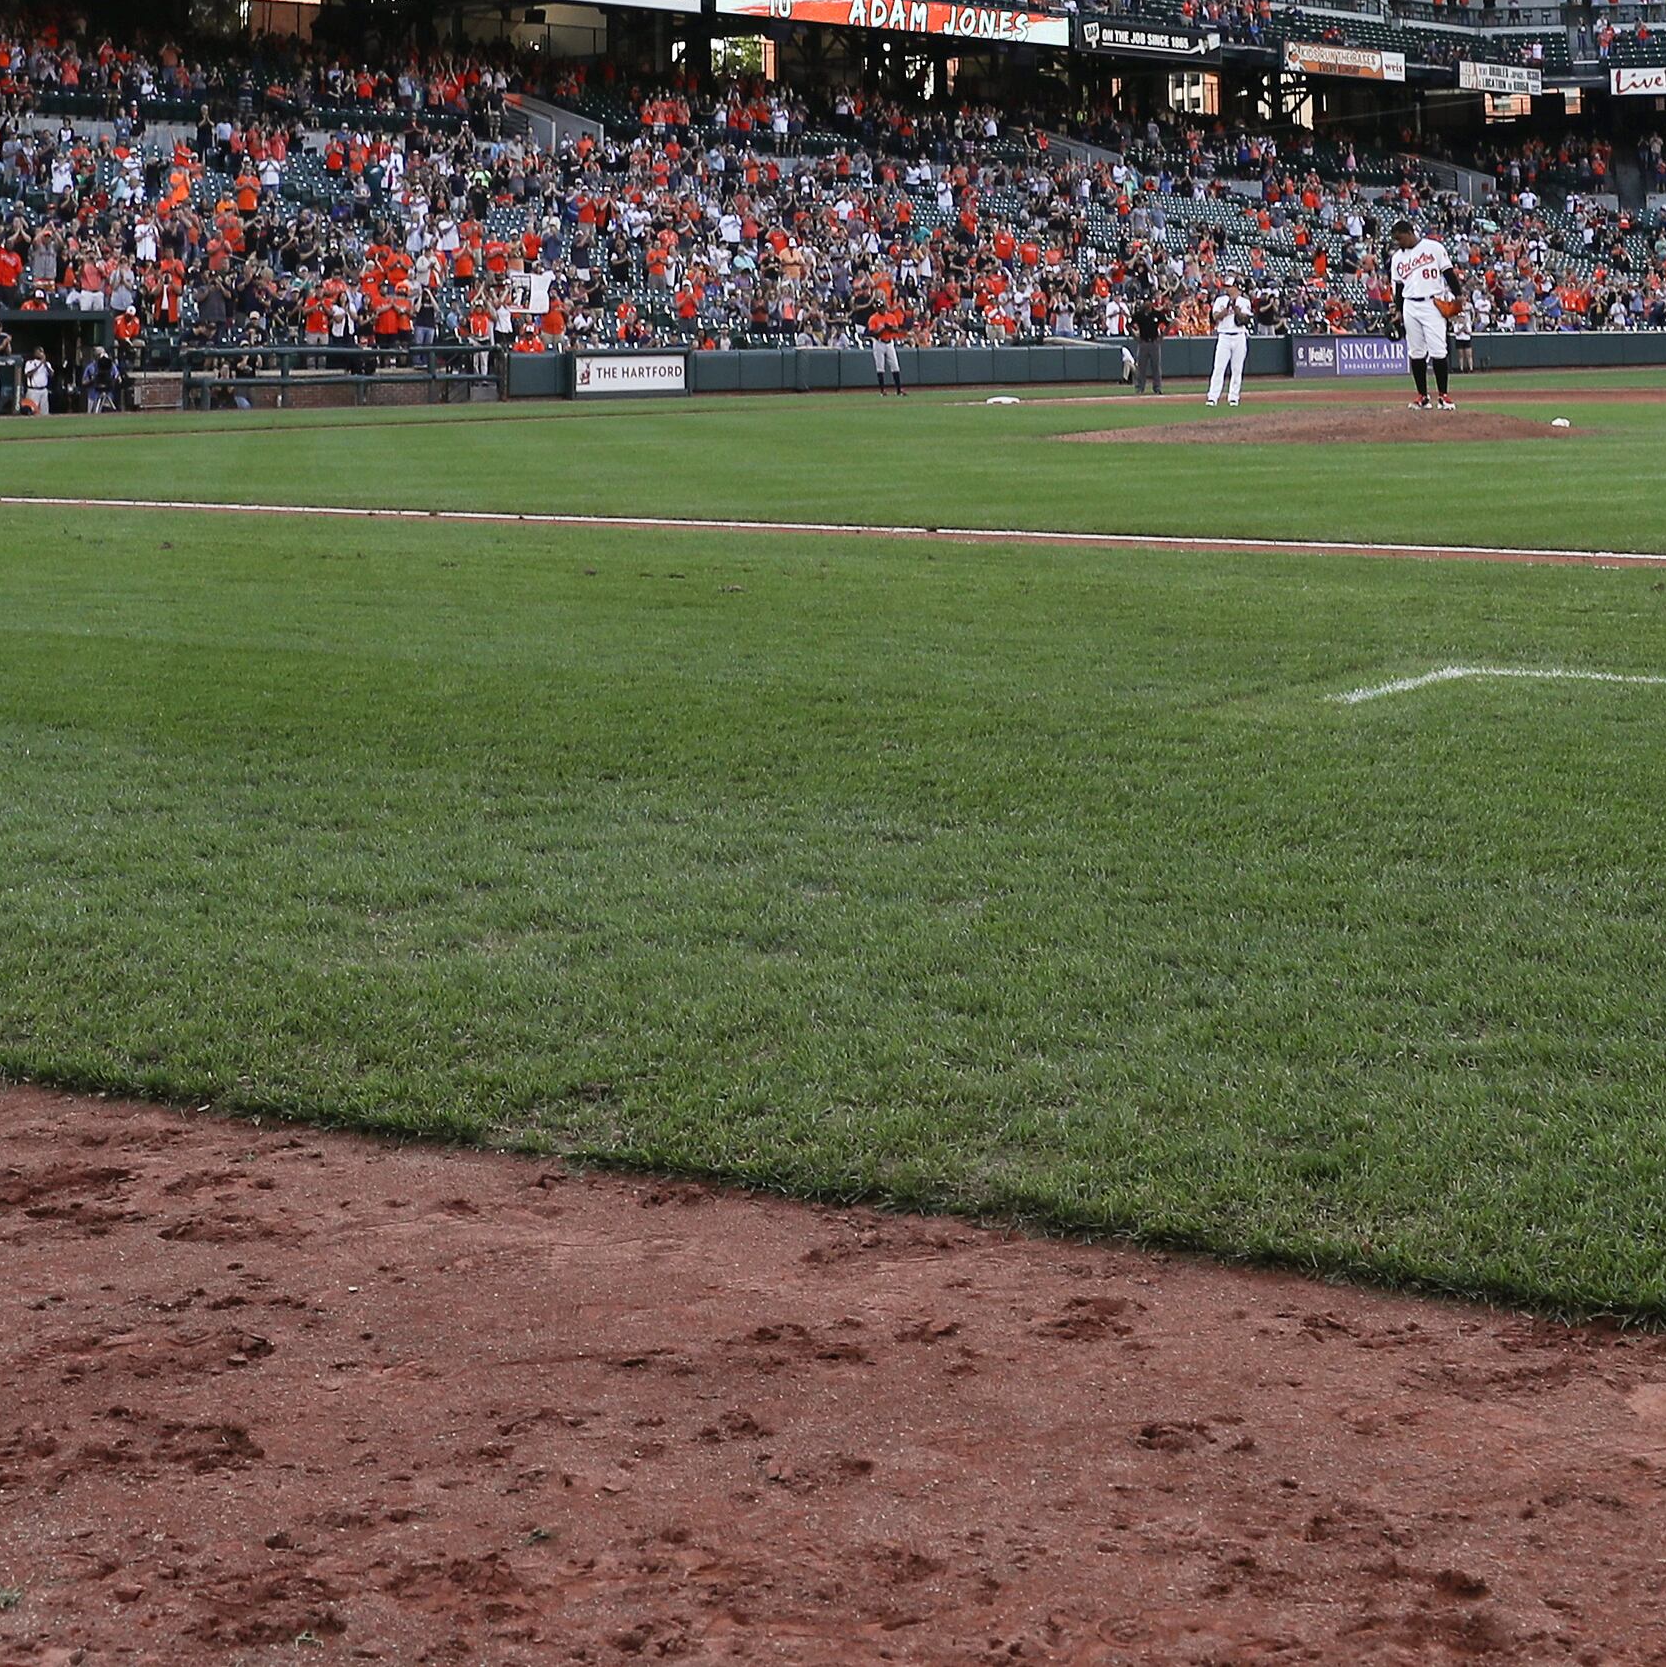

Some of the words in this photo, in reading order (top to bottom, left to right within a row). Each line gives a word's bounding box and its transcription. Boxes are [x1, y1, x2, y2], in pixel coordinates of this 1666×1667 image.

[943, 5, 1030, 42] JONES
[1101, 28, 1113, 42] ON
[1114, 29, 1130, 43] THE
[1130, 31, 1146, 46] JOB
[1147, 33, 1170, 48] SINCE
[1422, 268, 1438, 279] 60
[1340, 343, 1405, 360] SINCLAIR
[596, 367, 618, 379] THE
[621, 365, 683, 379] HARTFORD
